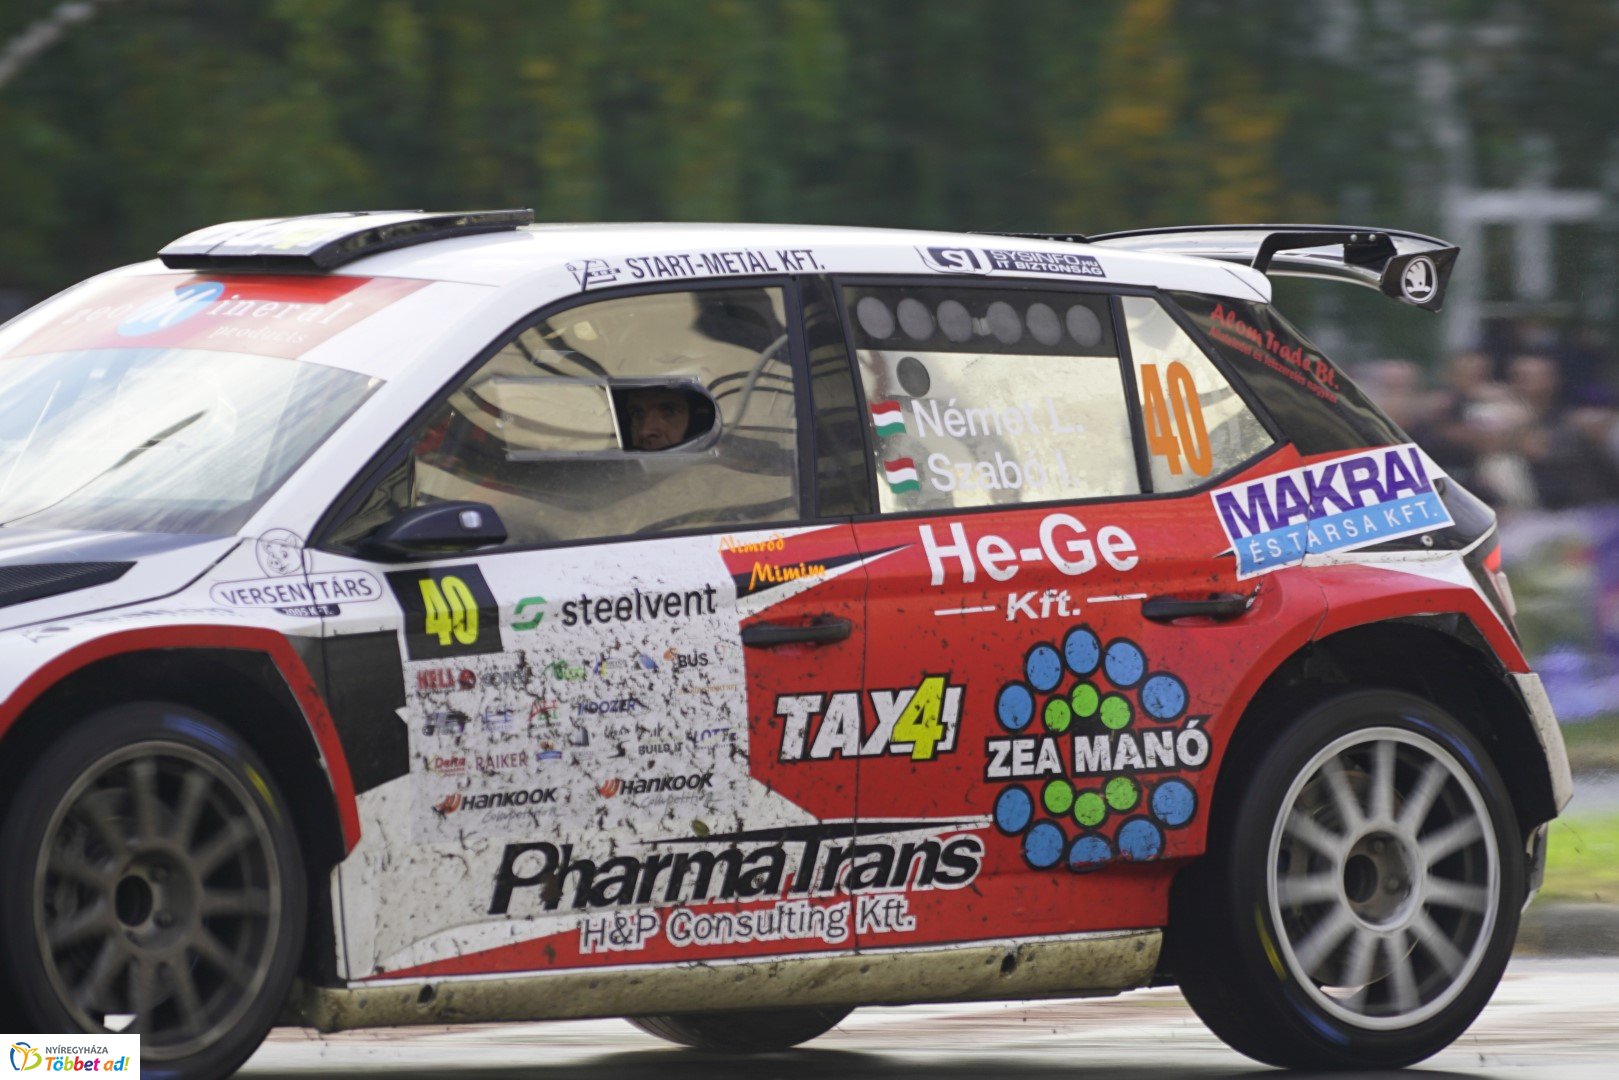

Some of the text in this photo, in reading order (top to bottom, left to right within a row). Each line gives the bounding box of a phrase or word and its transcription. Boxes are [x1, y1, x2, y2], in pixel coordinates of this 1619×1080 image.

[625, 248, 778, 279] START-METÁL
[776, 249, 825, 271] KFT.
[997, 261, 1103, 275] IT BIZTONSÁG
[1265, 329, 1311, 371] Trade
[1315, 359, 1340, 391] Bt.
[911, 399, 1041, 438] Német
[1140, 361, 1214, 477] 40
[927, 450, 1046, 492] Szabó
[1215, 447, 1432, 539] MAKRAI
[919, 513, 1139, 587] He-Ge
[1248, 539, 1282, 563] ÉS
[1385, 501, 1439, 527] KFT.
[220, 576, 373, 605] VERSENYTÁRS
[418, 576, 479, 646] 40
[561, 583, 717, 627] steelvent
[1006, 588, 1082, 621] Kft.
[677, 653, 709, 668] BUS
[475, 750, 528, 772] RAIKER
[987, 719, 1209, 778] ZEA MANÓ
[487, 837, 983, 916] PharmaTrans
[583, 897, 915, 948] H&P Consulting Kft.
